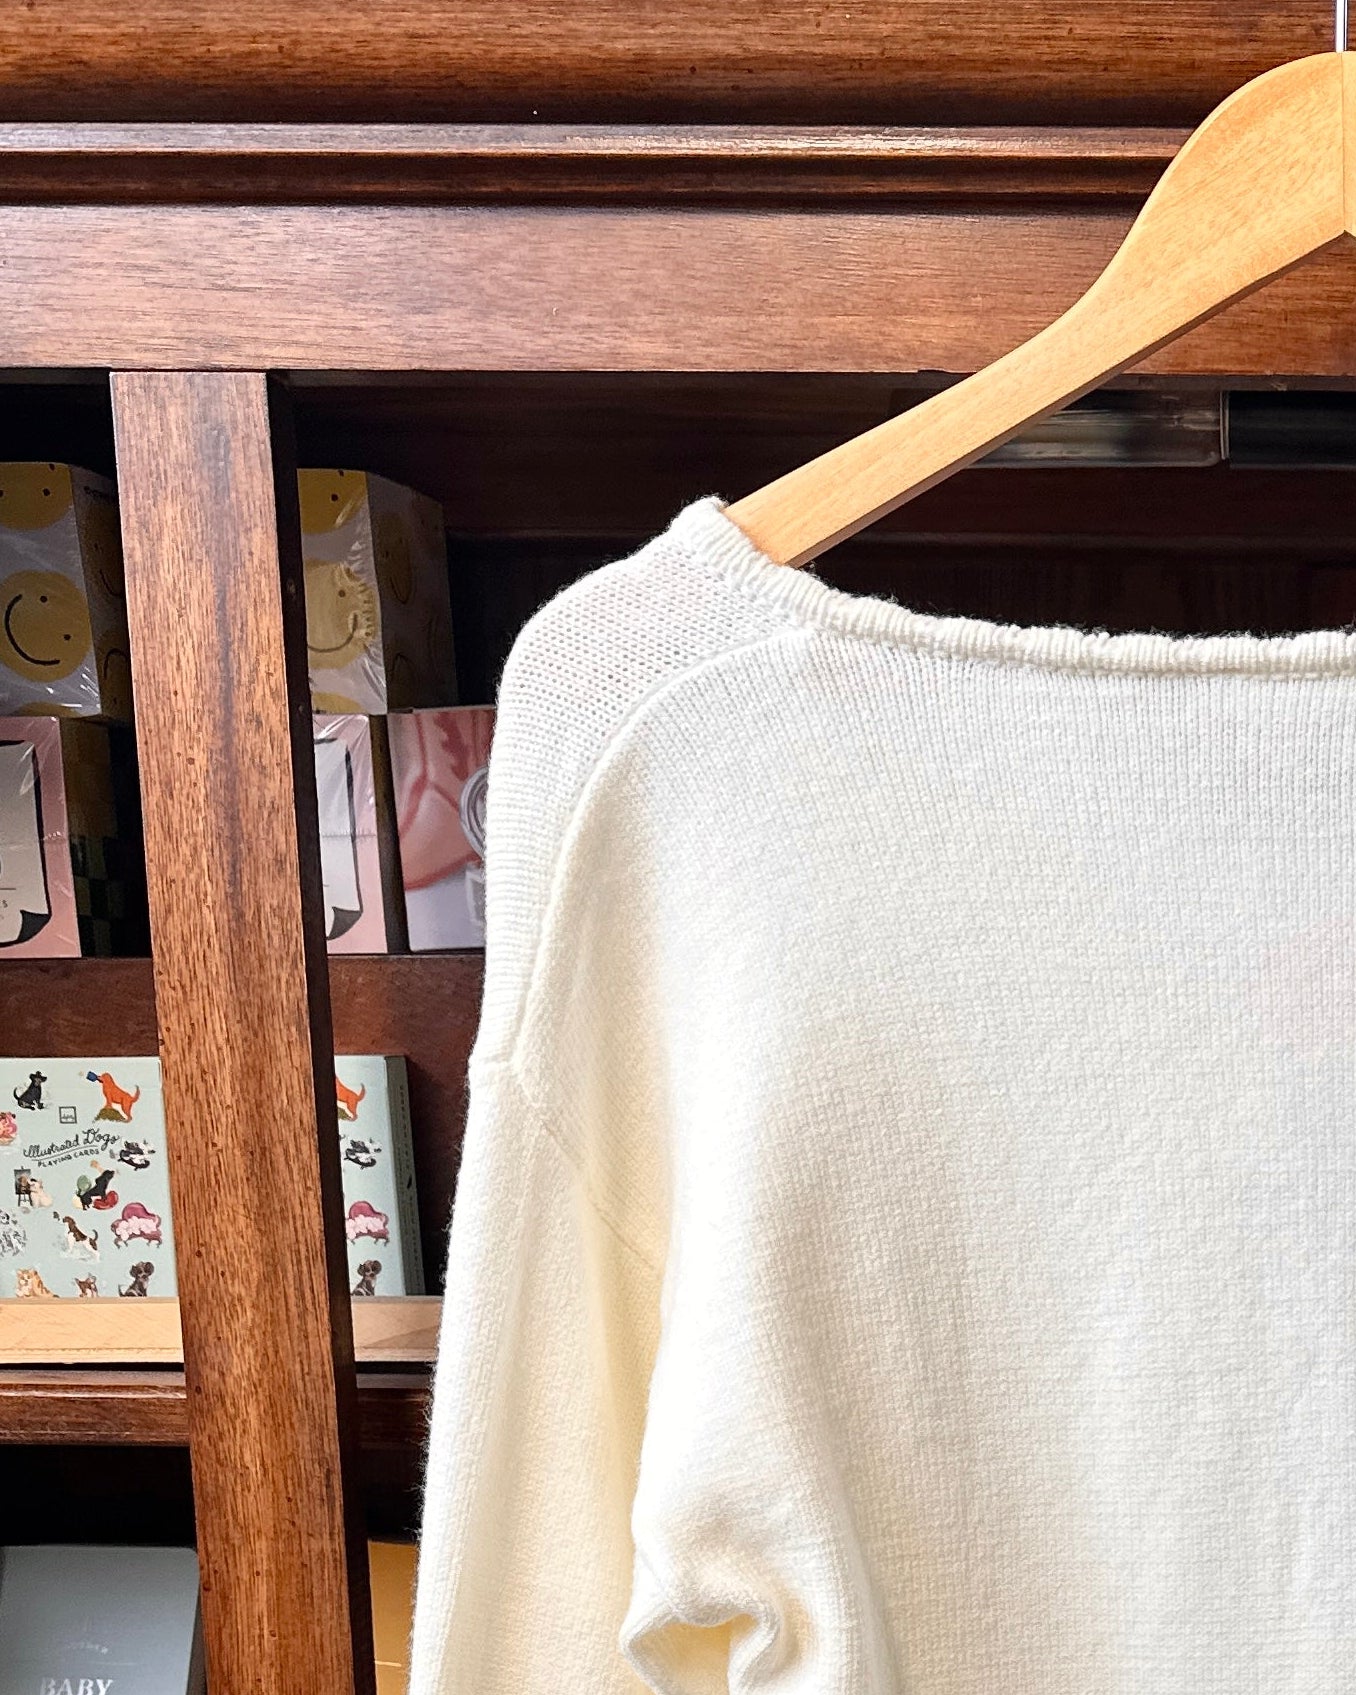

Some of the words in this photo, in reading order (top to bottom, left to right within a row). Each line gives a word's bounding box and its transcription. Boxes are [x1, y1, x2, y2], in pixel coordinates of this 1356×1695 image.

[23, 1134, 79, 1158] Illustrated
[83, 1128, 120, 1151] Dogs
[38, 1153, 72, 1168] PLAYING
[74, 1148, 100, 1159] CARDS
